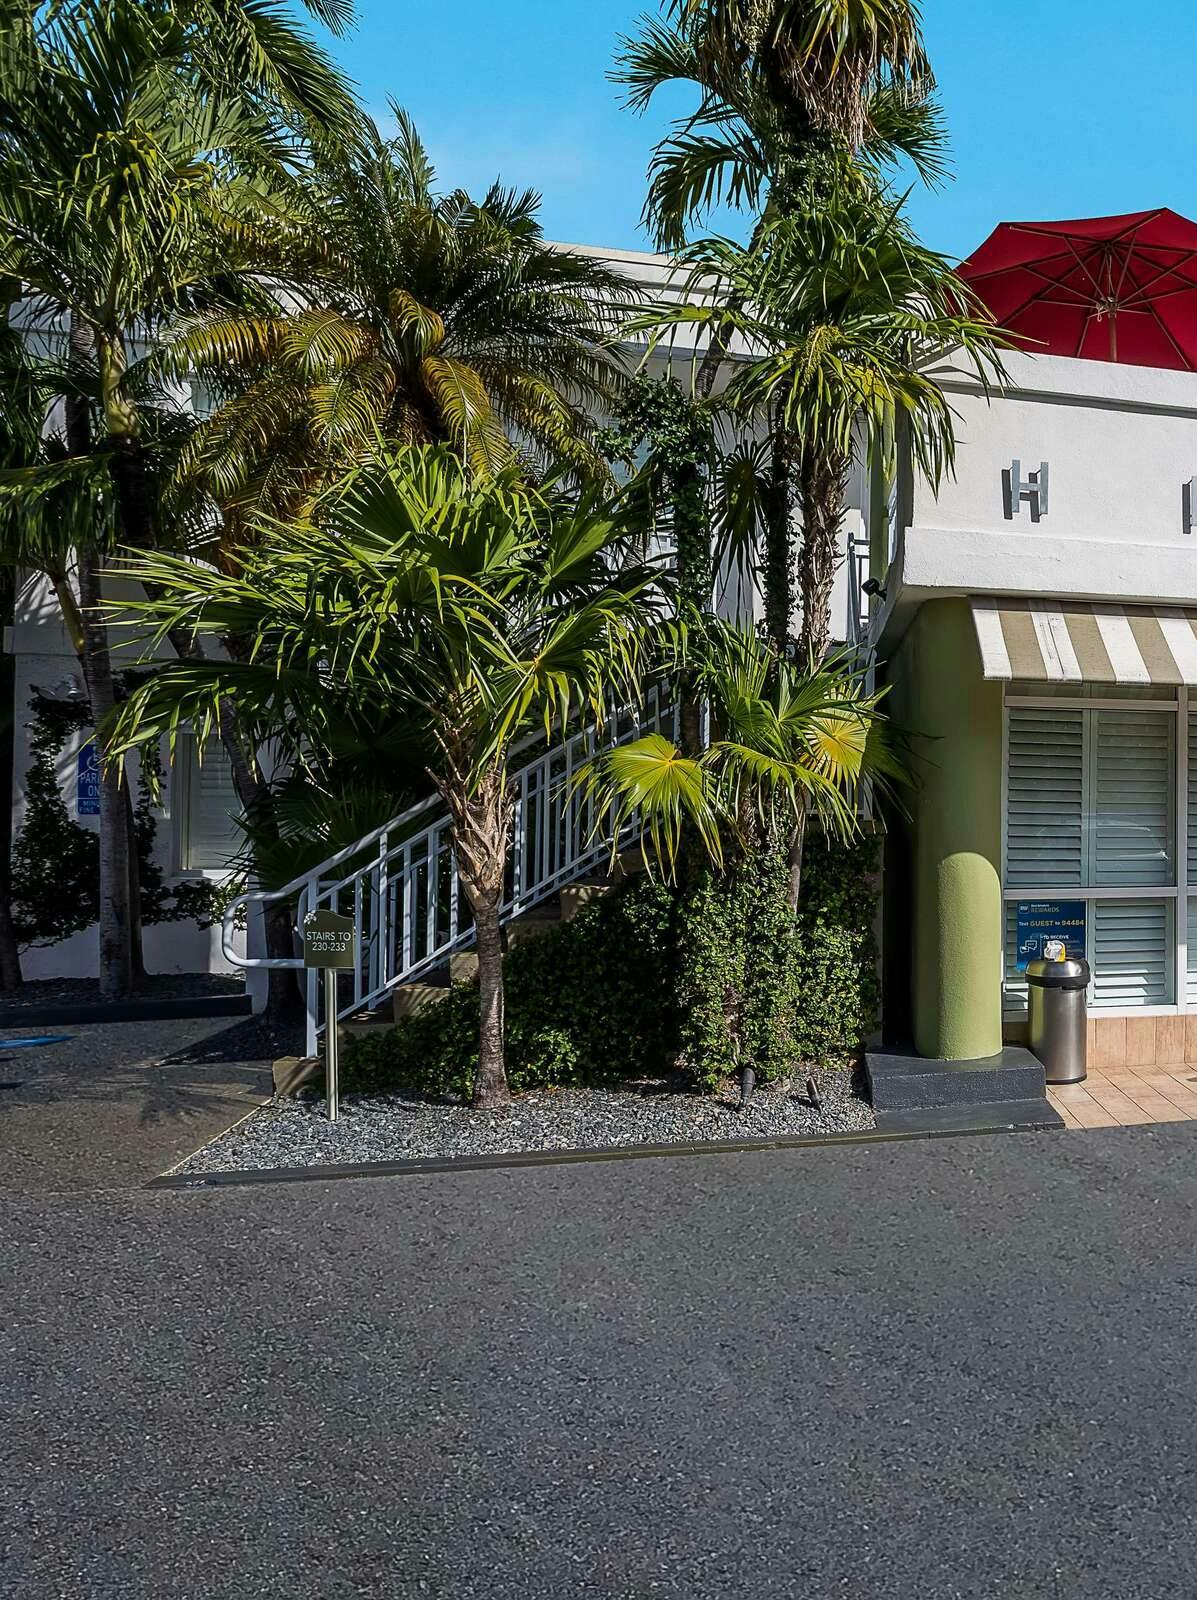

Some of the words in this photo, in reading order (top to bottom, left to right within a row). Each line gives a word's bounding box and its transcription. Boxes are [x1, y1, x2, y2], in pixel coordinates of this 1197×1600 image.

[306, 931, 336, 941] STAIRS
[338, 931, 352, 941] TO
[312, 941, 346, 952] 230-233
